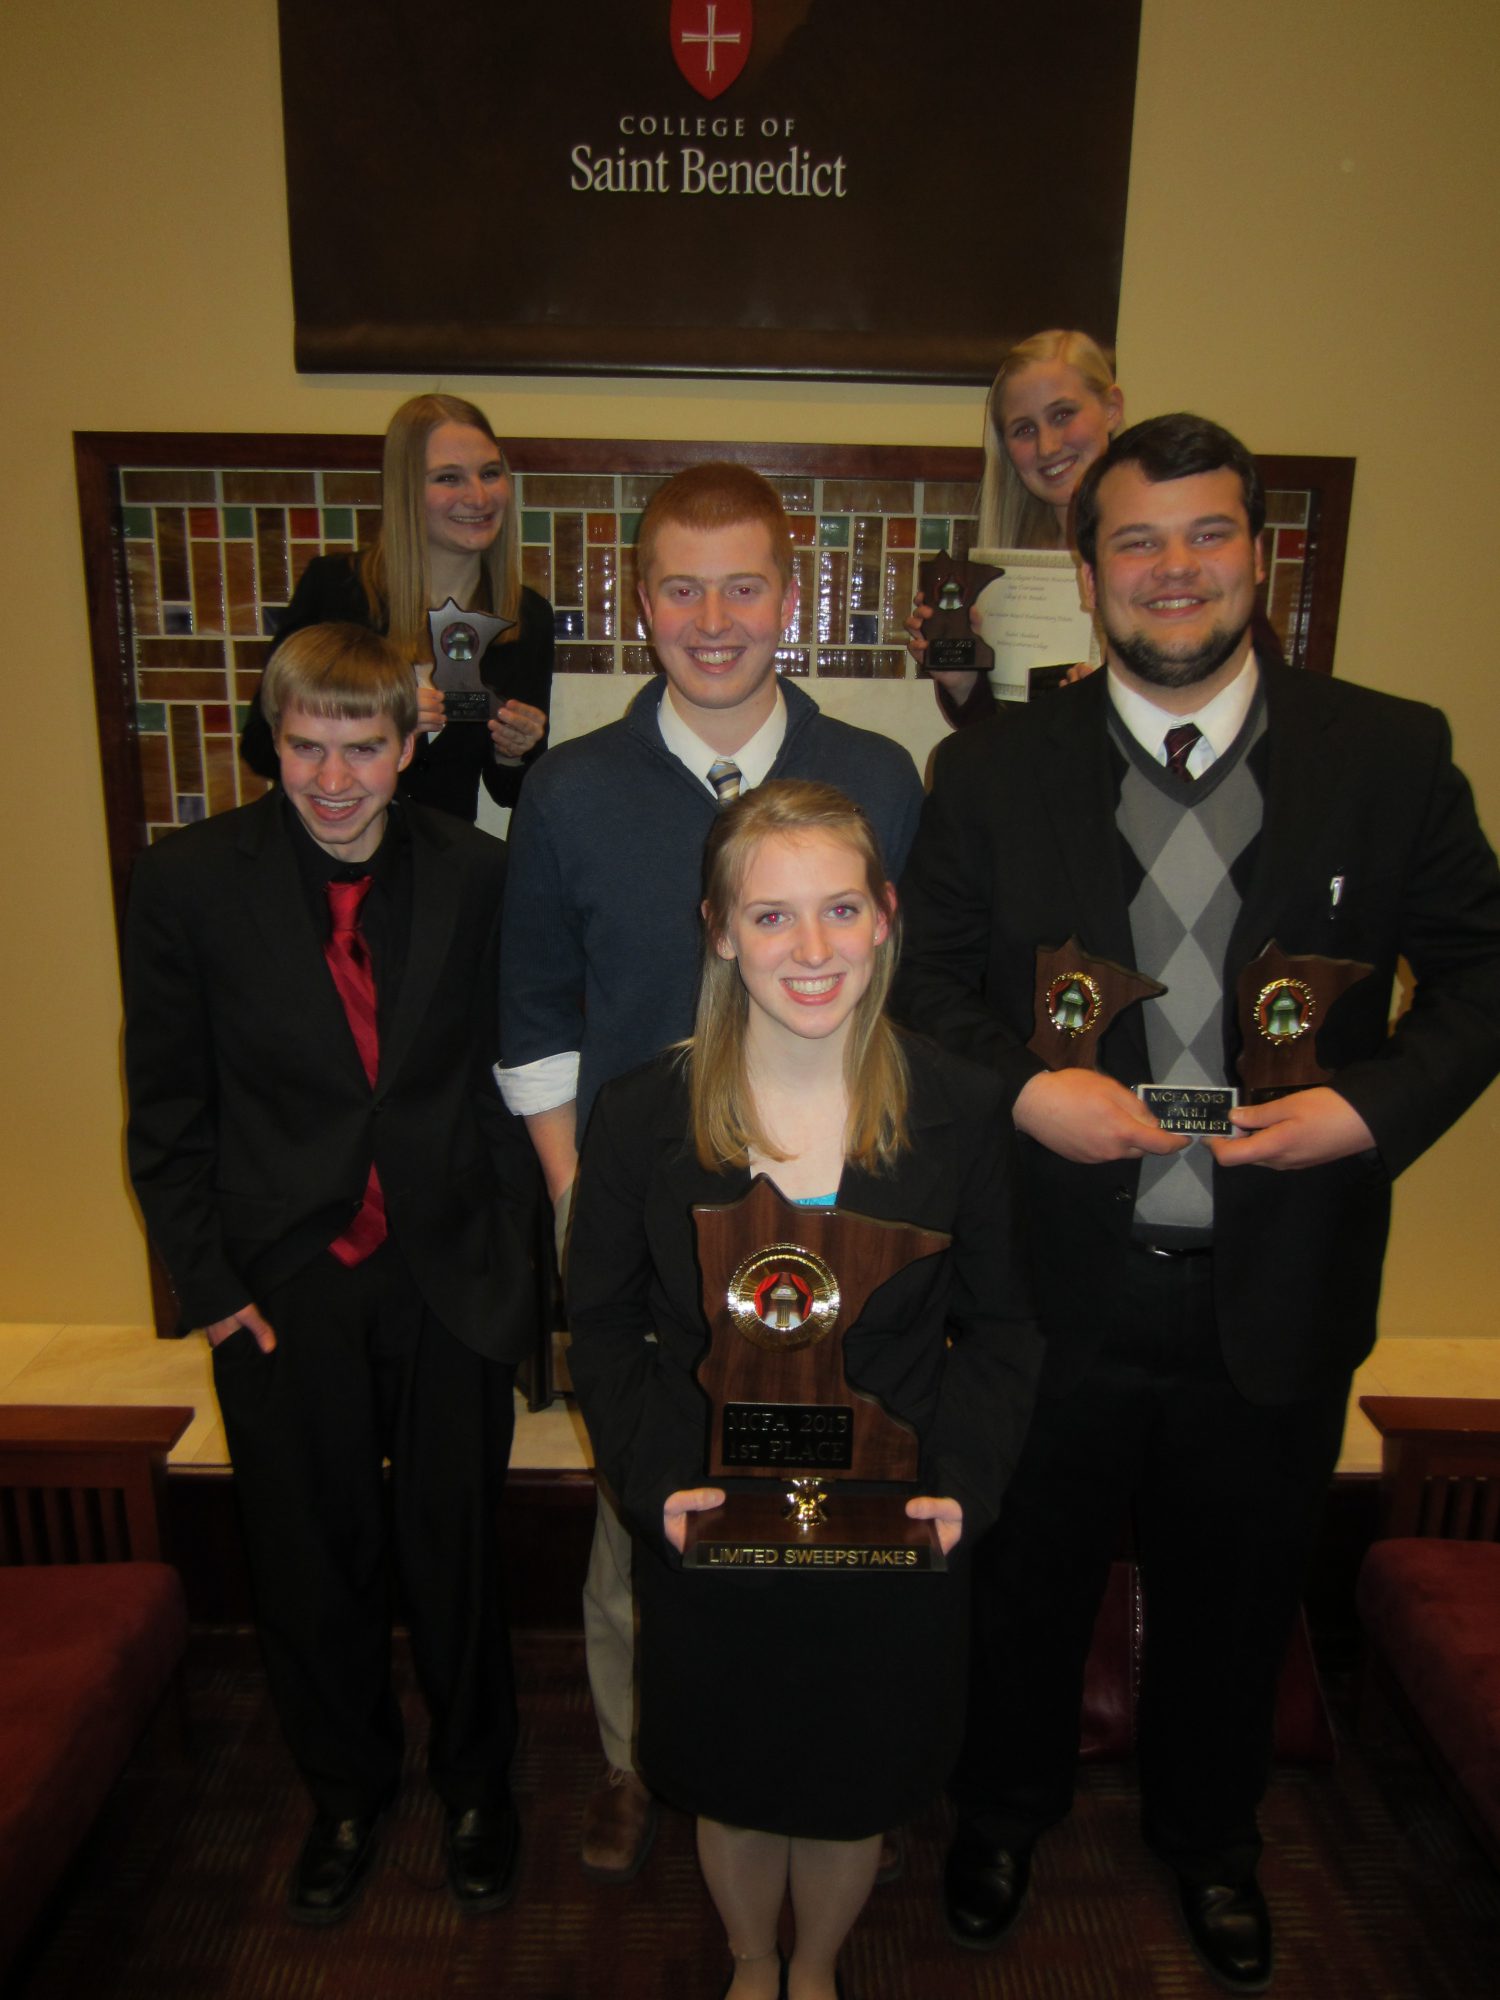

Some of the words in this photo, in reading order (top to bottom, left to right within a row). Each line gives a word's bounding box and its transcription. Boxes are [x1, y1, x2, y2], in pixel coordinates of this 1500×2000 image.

[619, 116, 745, 137] COLLEGE
[760, 118, 796, 137] OF
[570, 145, 670, 192] Saint
[680, 146, 847, 197] Benedict
[1150, 1091, 1191, 1103] MCFA
[1194, 1093, 1226, 1104] 2013
[1167, 1107, 1208, 1118] PARLI
[769, 1440, 846, 1461] PLACE
[709, 1548, 778, 1564] LIMITED
[784, 1550, 918, 1566] SWEEPSTAKES
